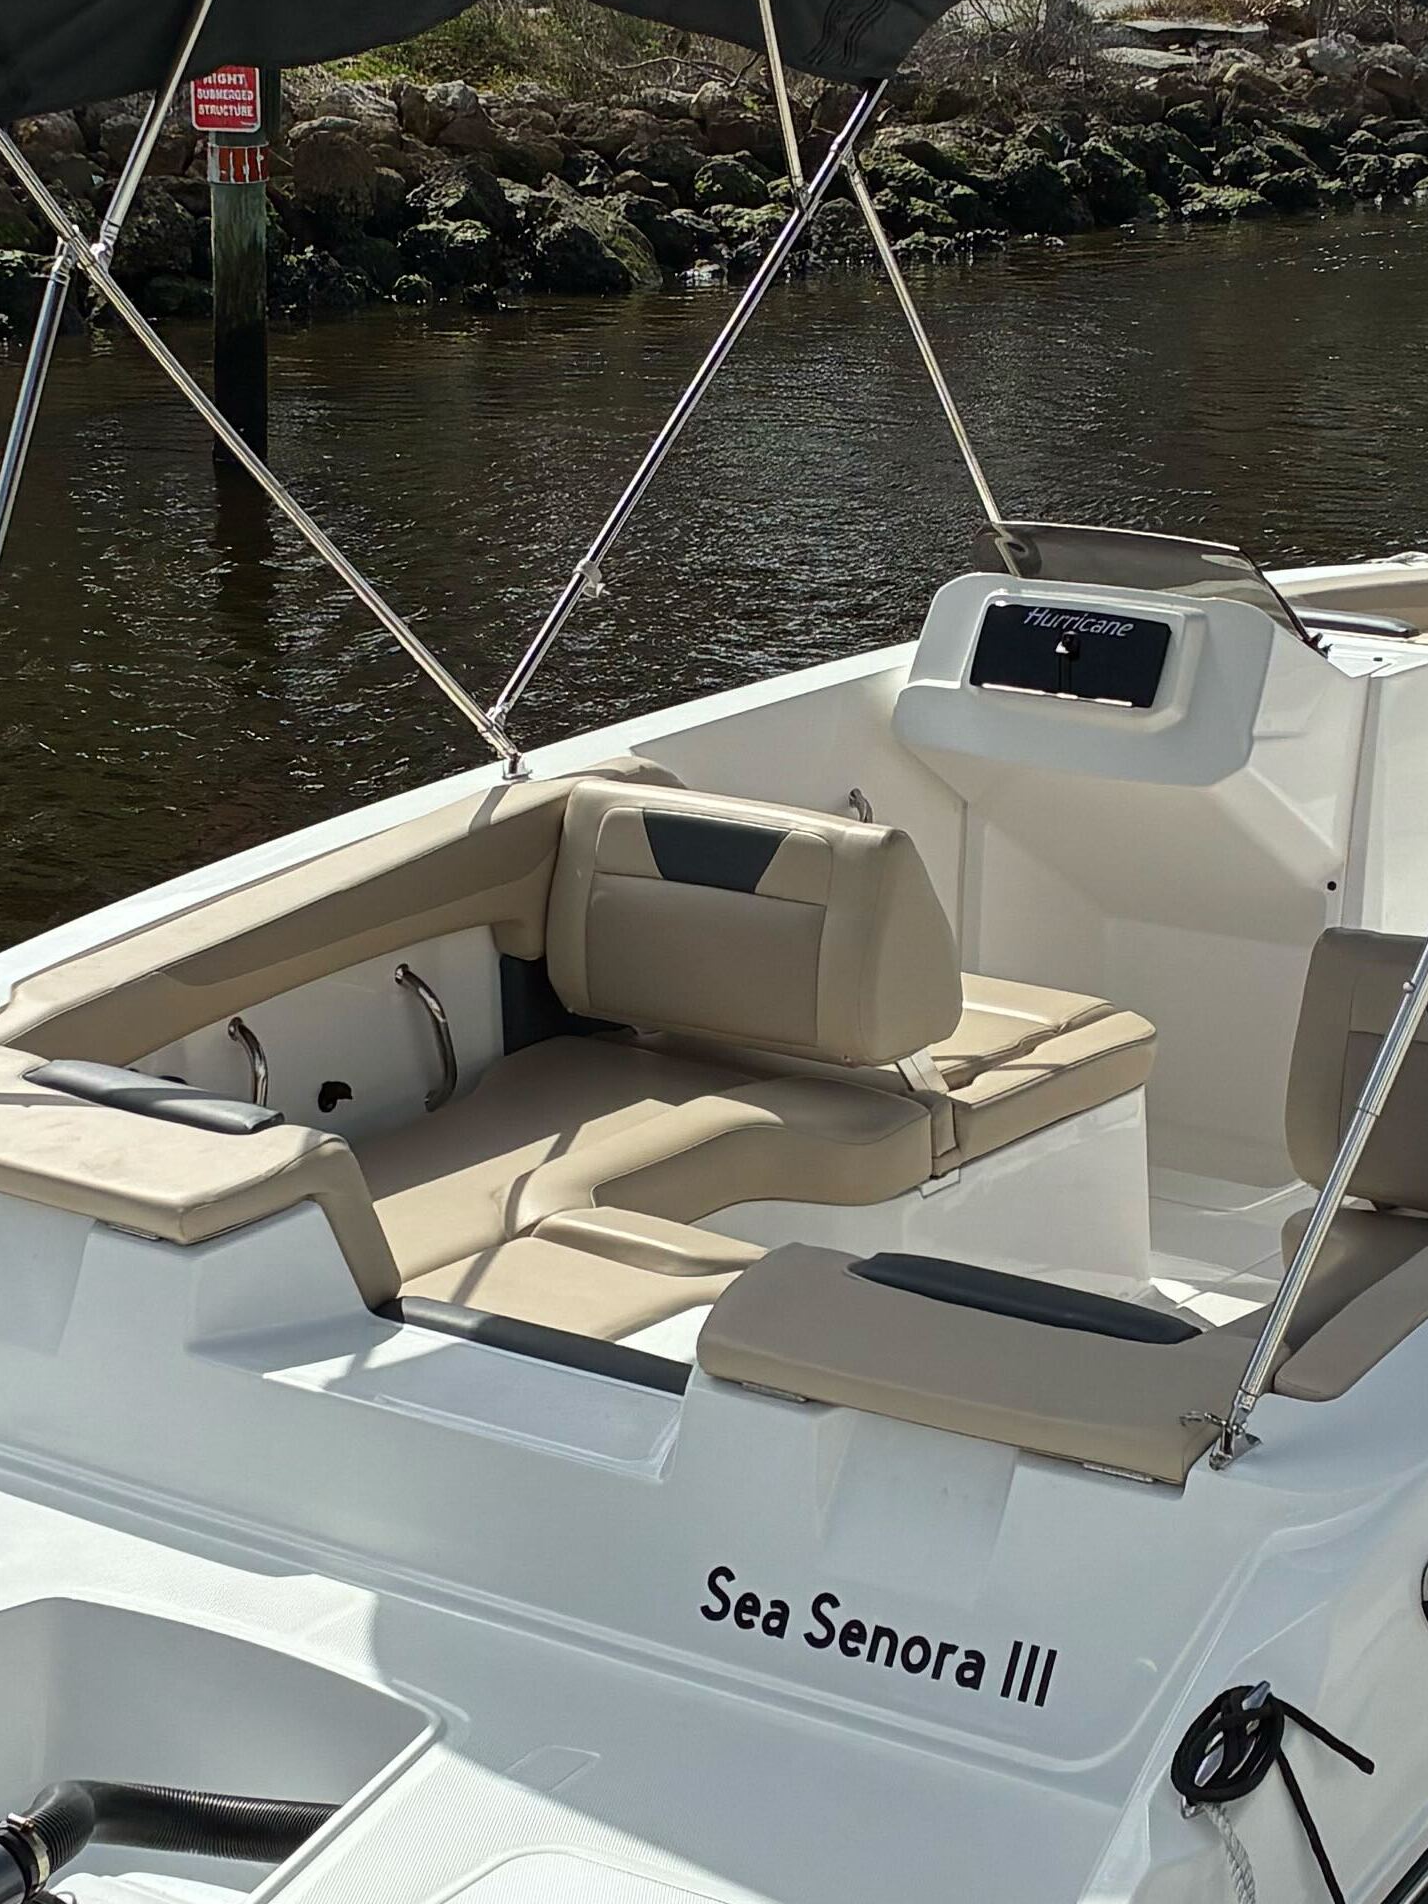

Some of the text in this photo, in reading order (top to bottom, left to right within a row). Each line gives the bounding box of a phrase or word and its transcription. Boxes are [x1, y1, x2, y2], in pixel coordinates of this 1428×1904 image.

[197, 88, 254, 101] SUBMERGED
[198, 104, 254, 117] STRUCTURE
[1024, 607, 1136, 638] Hurricane
[700, 1566, 1058, 1708] Sea Senora III
